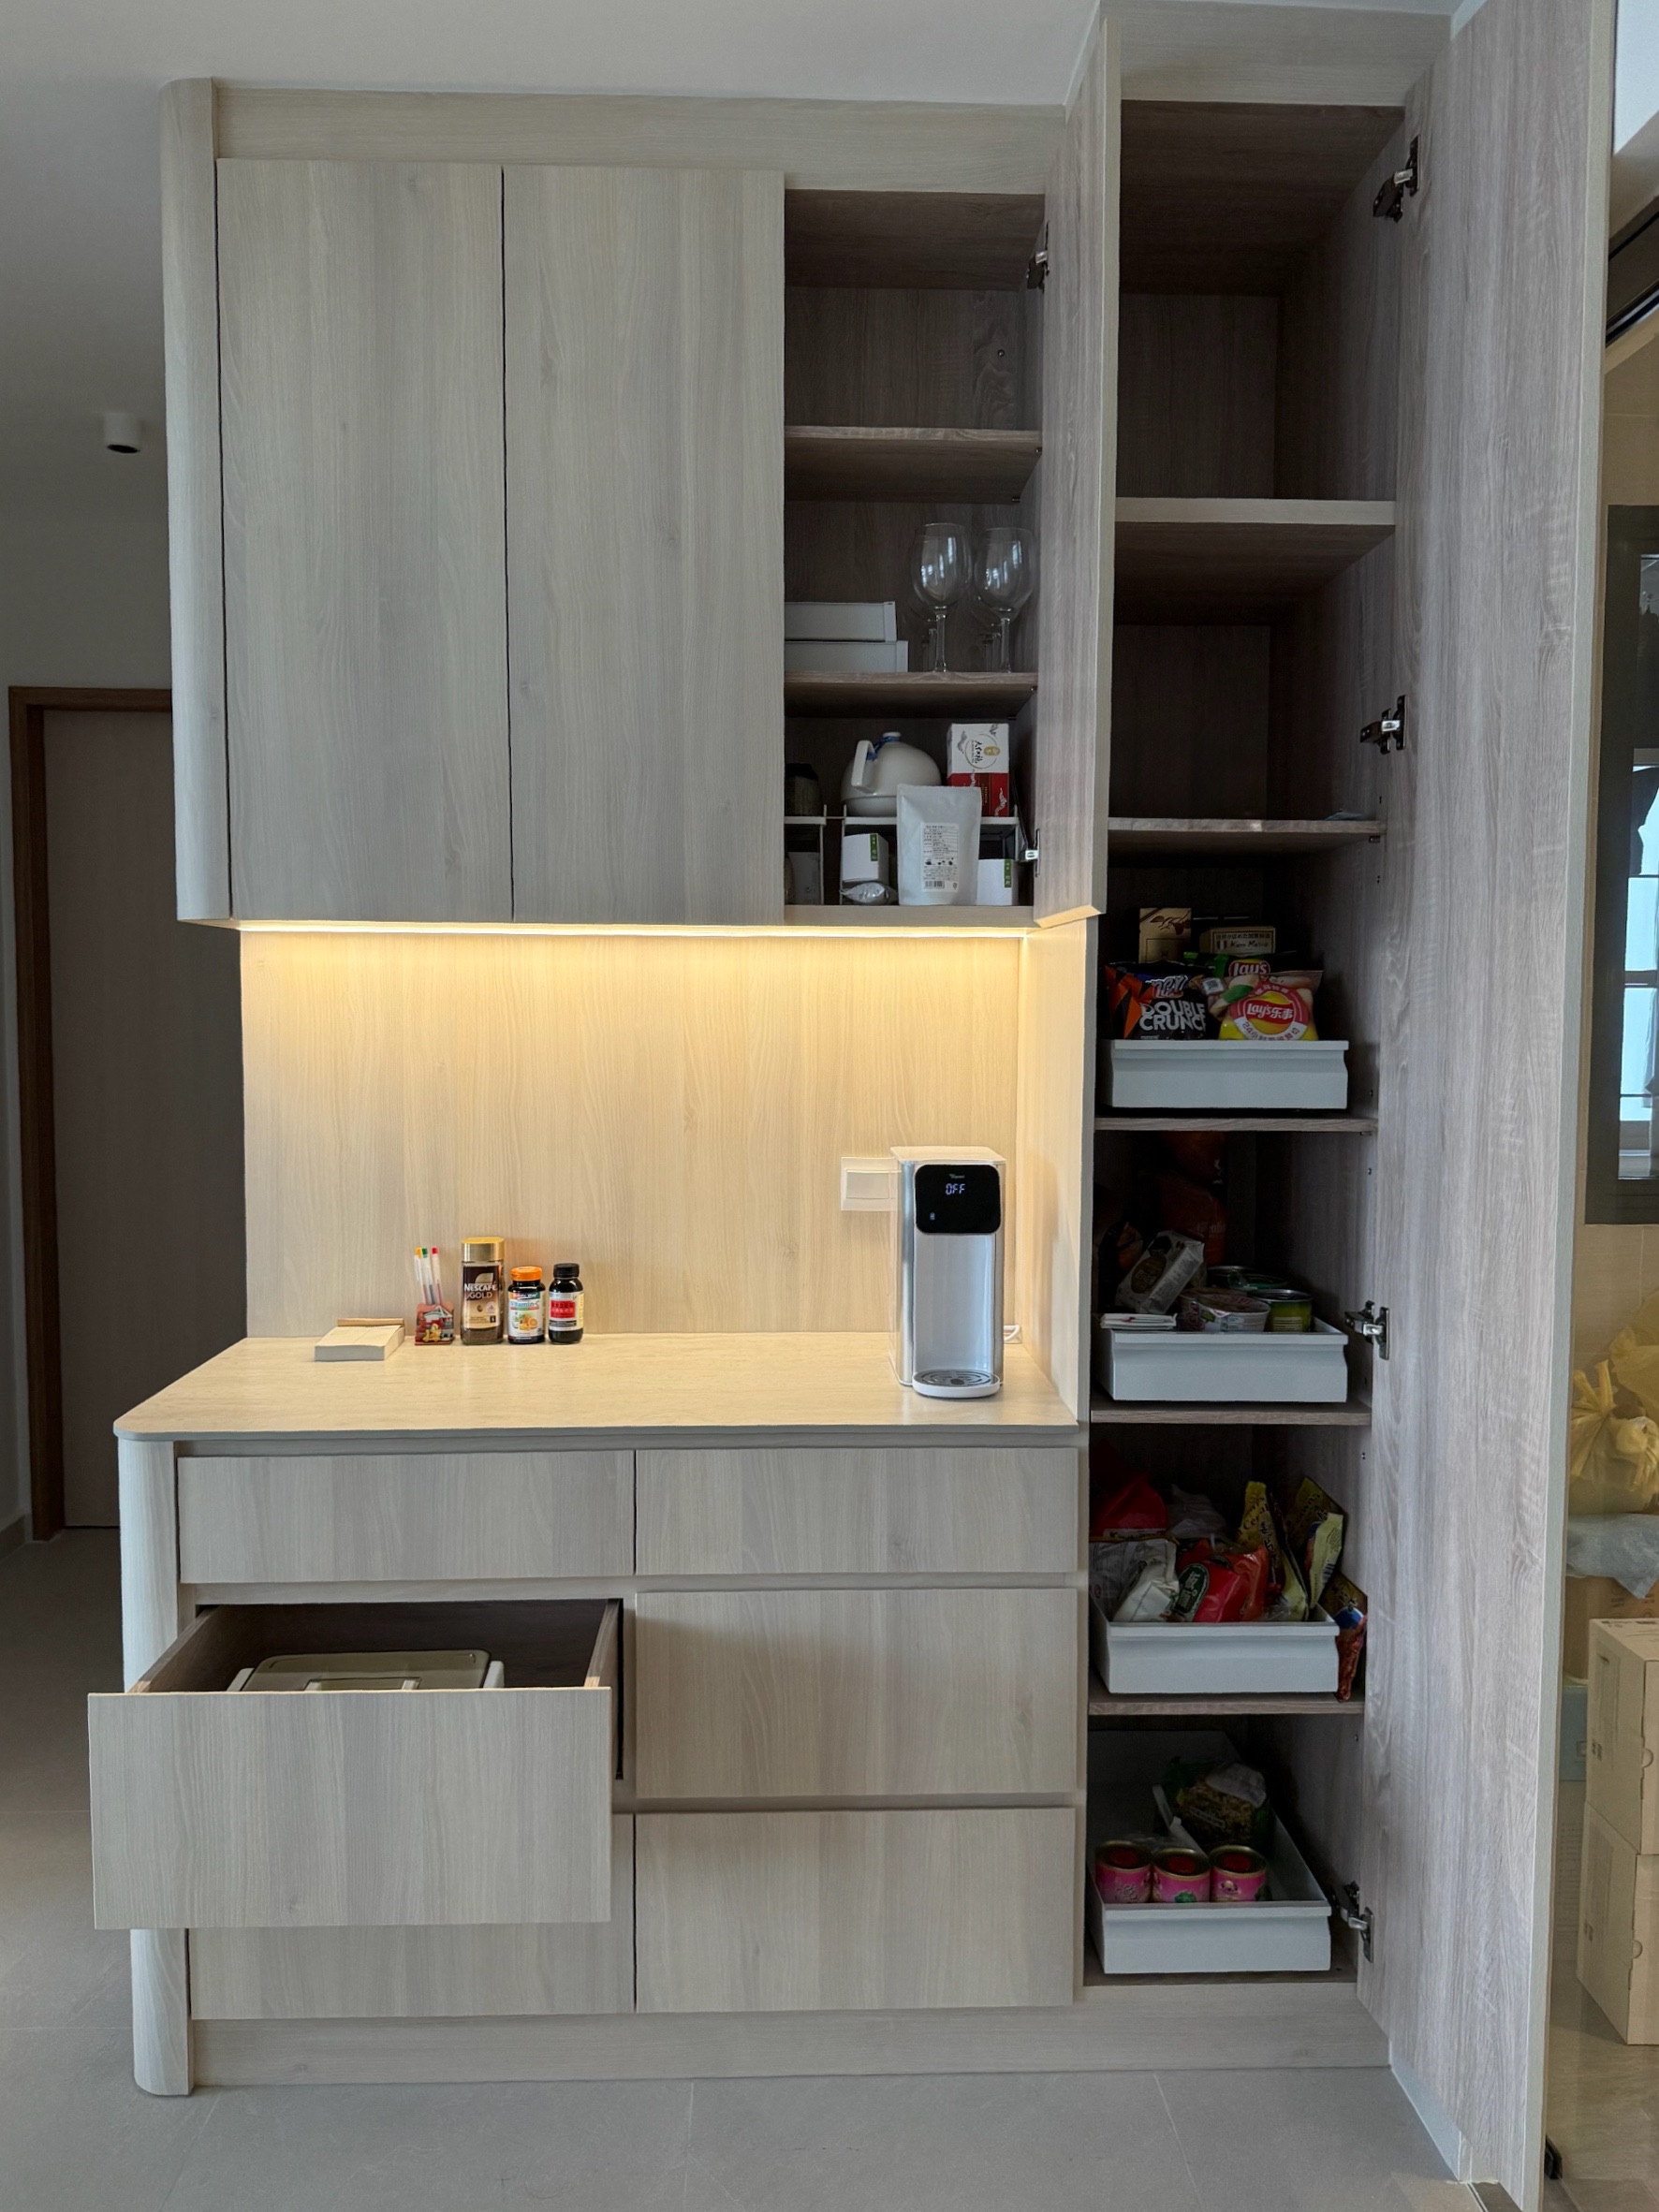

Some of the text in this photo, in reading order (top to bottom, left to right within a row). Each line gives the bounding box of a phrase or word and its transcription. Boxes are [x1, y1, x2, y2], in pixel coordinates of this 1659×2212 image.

[1139, 1000, 1206, 1018] DOUBLE
[946, 1182, 965, 1195] OFF
[464, 1281, 497, 1292] NESCAFÉ
[1243, 1503, 1270, 1530] Ceral
